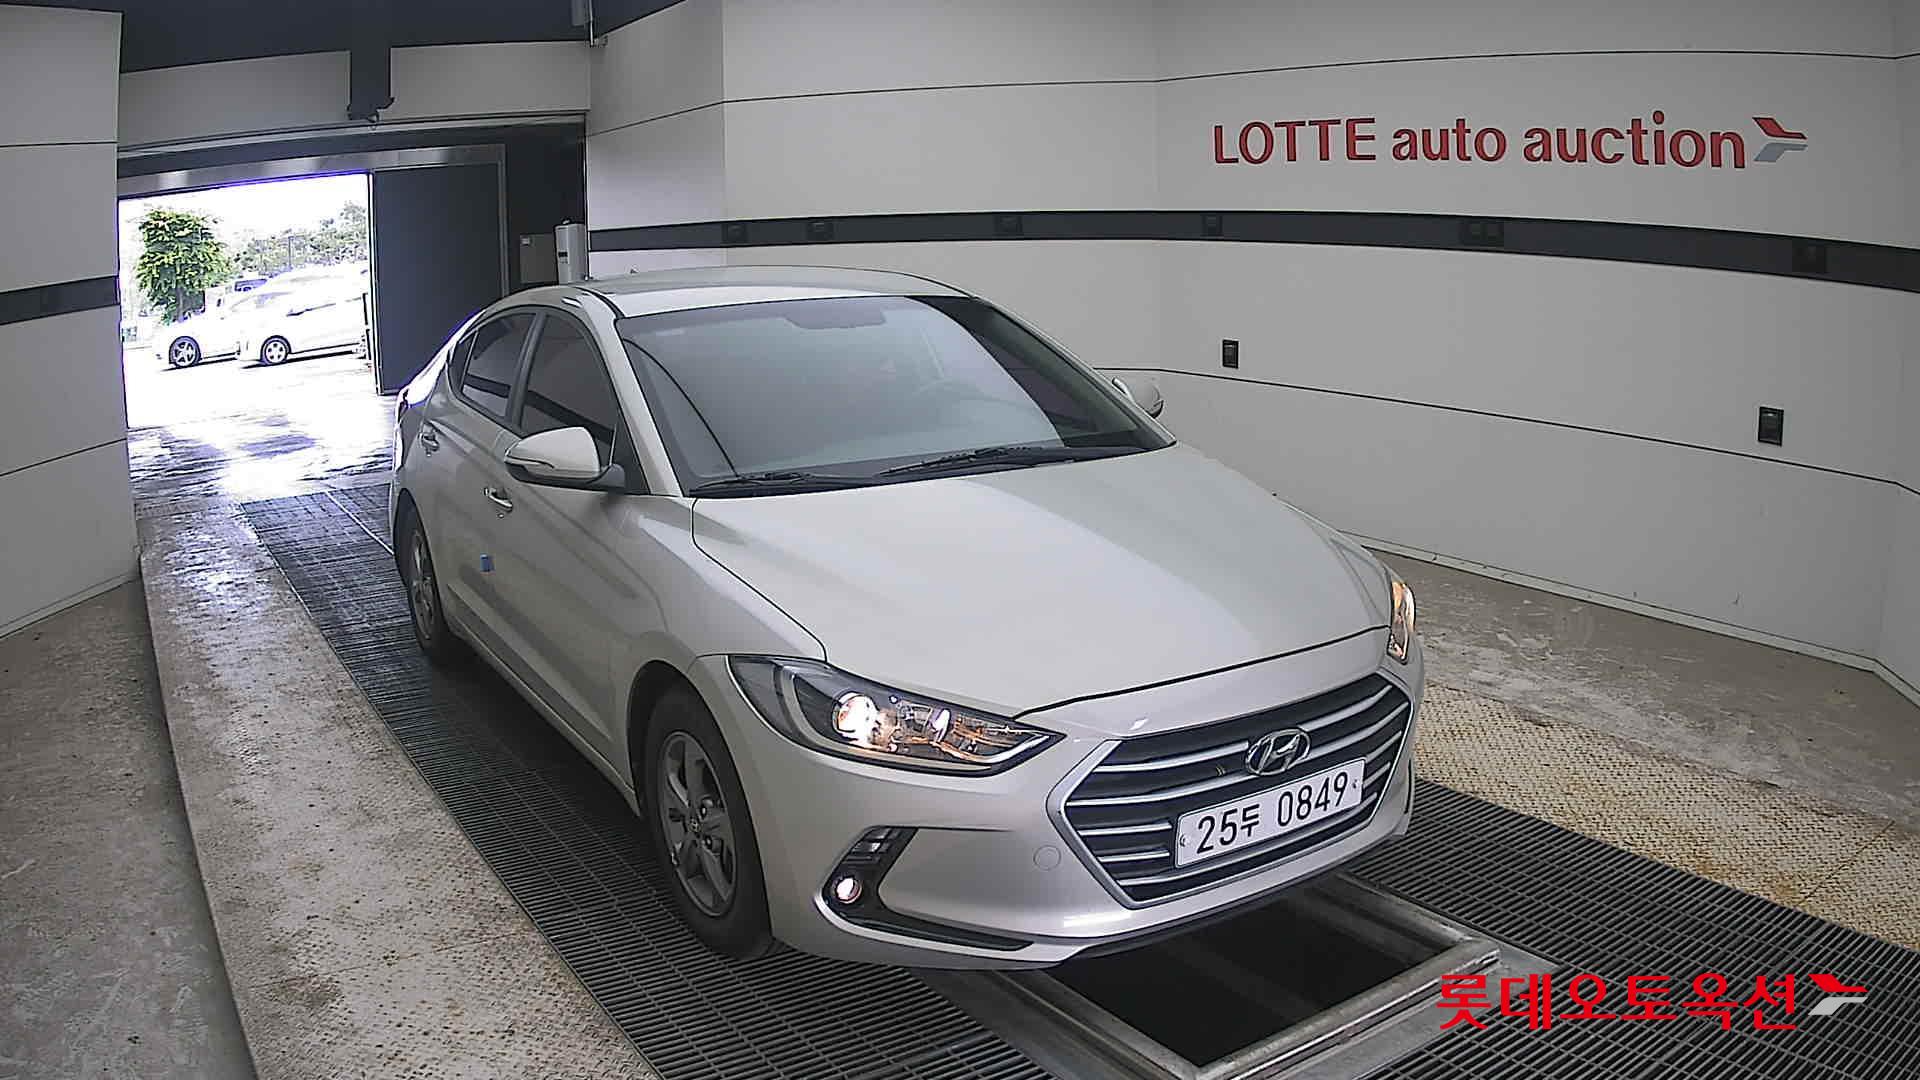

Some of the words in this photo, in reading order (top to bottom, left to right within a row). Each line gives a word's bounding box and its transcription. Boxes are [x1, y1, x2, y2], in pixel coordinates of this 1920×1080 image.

[1213, 116, 1376, 165] LOTTE
[1392, 118, 1507, 163] auto
[1523, 110, 1746, 169] auction
[1196, 803, 1260, 855] 25두
[1277, 771, 1348, 827] 0849
